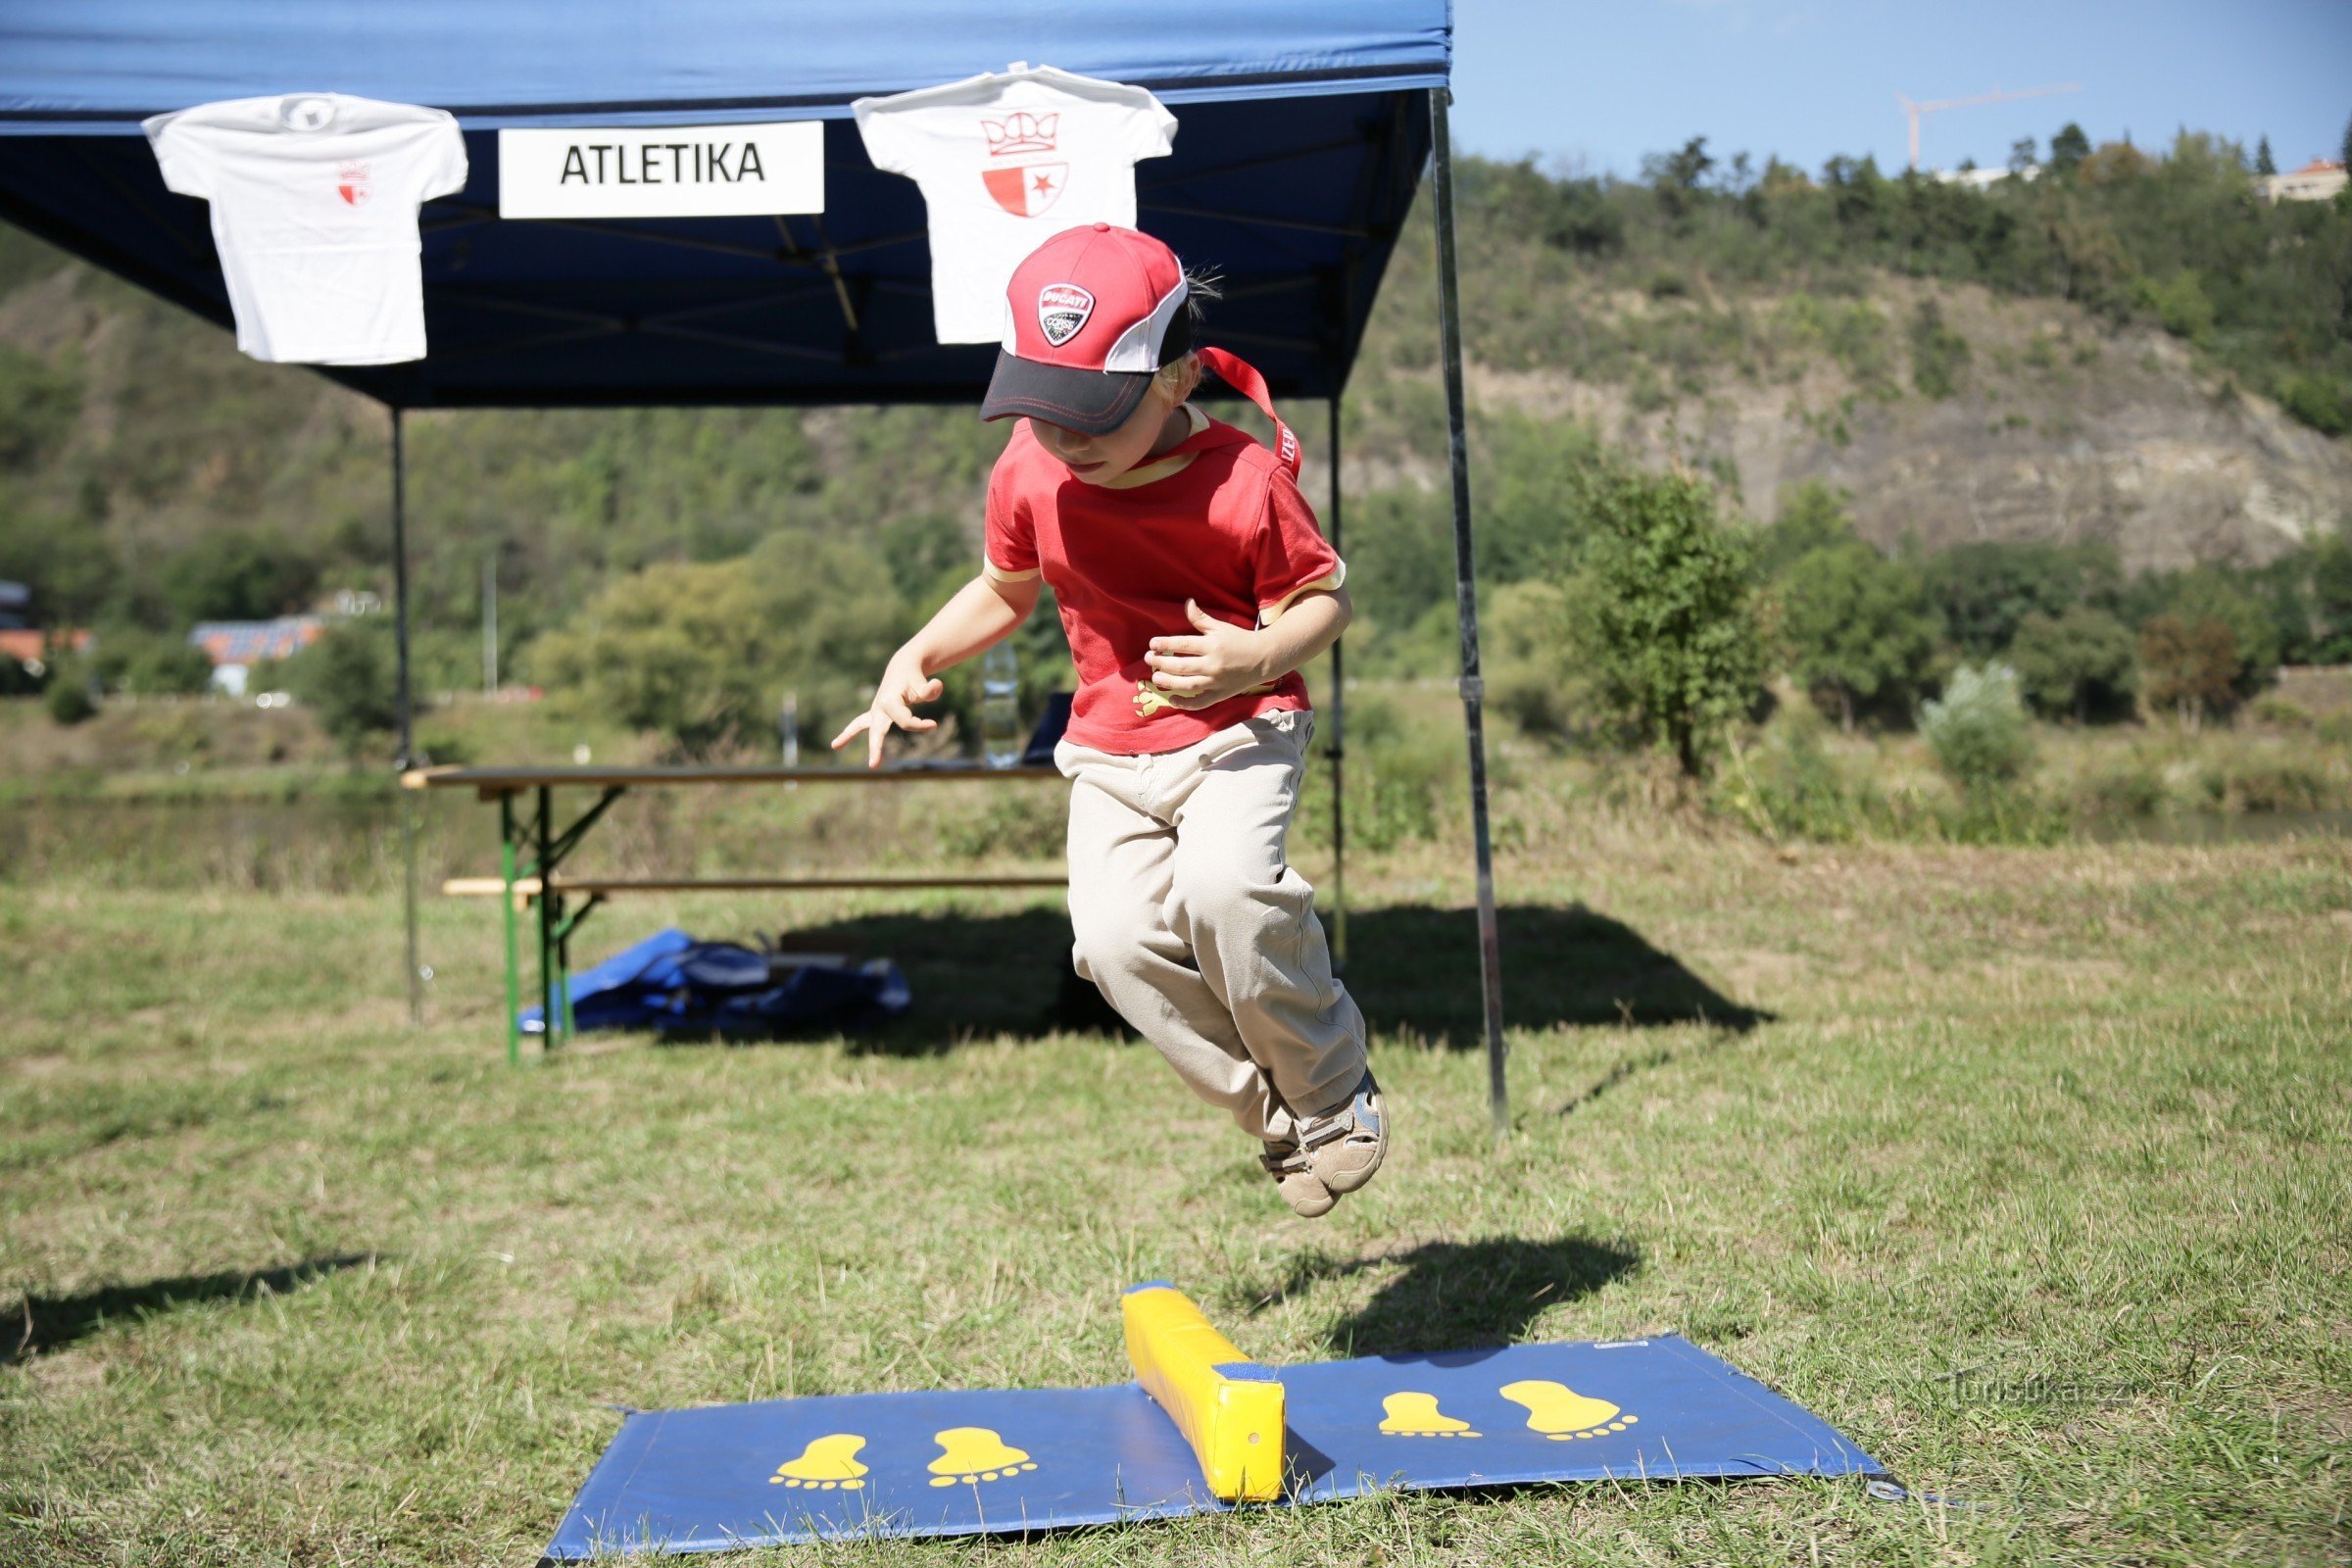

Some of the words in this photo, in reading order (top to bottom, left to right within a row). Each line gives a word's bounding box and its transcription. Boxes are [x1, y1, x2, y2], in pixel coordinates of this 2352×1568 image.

[561, 142, 765, 184] ATLETIKA
[1043, 291, 1089, 309] DUCATI
[1045, 317, 1076, 331] CORSE
[1281, 427, 1295, 466] IZED
